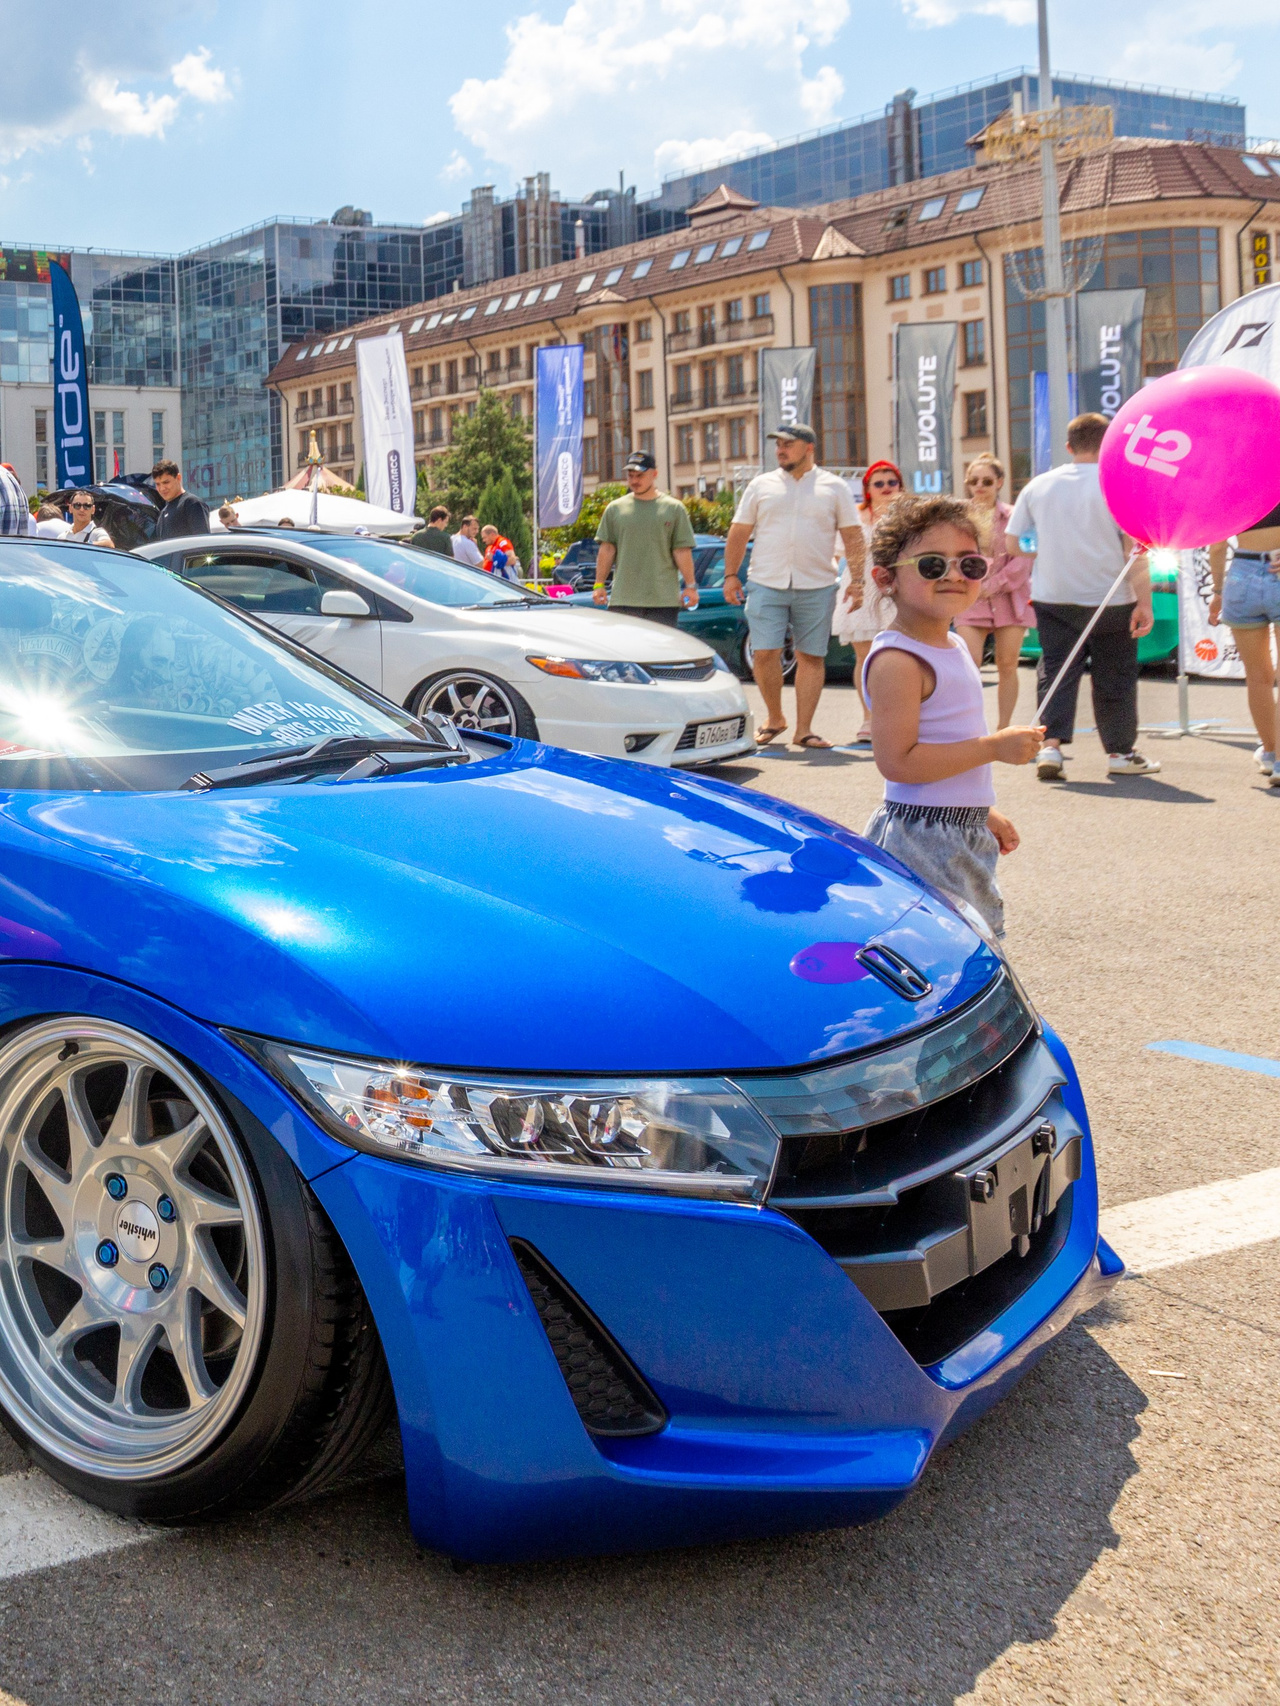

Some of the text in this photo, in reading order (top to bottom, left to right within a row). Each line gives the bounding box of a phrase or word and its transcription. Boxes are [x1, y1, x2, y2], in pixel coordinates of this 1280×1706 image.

[918, 355, 937, 462] EVOLUTE
[1123, 414, 1192, 479] t2
[390, 454, 401, 511] АВТОКЛАСС
[227, 701, 363, 736] UNDER HOOD
[270, 721, 317, 746] BOYS
[119, 1220, 156, 1240] whistler
